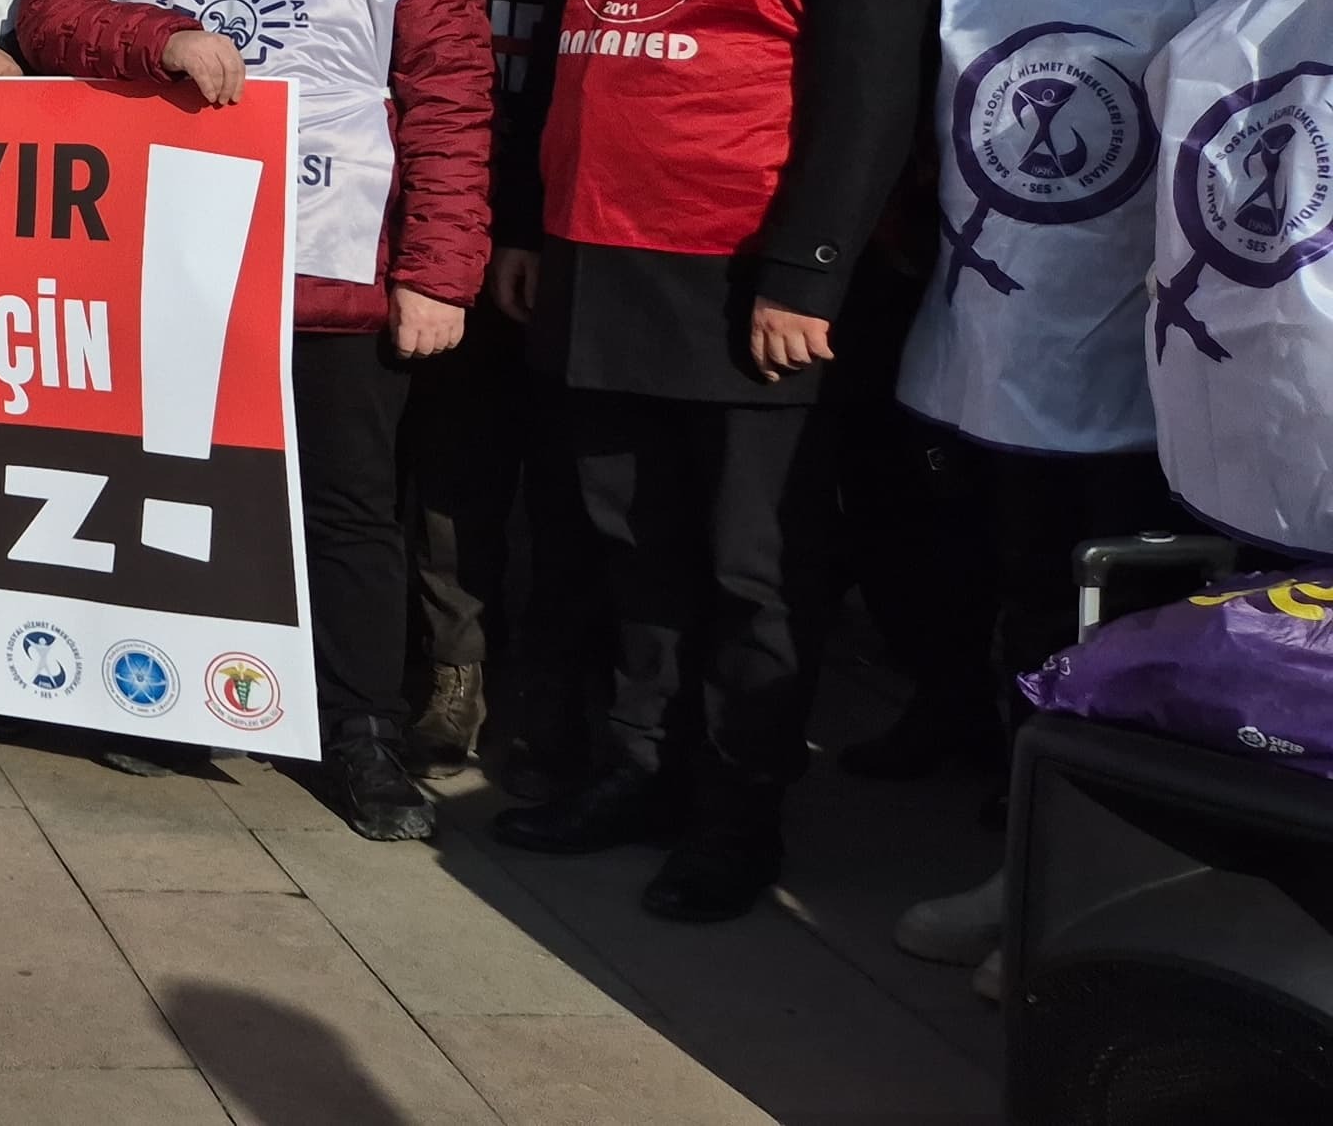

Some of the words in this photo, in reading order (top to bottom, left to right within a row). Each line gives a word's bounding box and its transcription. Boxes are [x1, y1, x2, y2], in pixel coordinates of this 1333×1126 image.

[603, 0, 638, 17] 2011
[558, 29, 699, 60] ANKAHED
[1018, 62, 1064, 80] HİZMET
[984, 76, 1015, 117] SOSYAL
[1066, 64, 1126, 125] EMEKÇİLERİ
[1215, 121, 1265, 161] SOSYAL
[297, 154, 332, 187] SI
[982, 139, 1011, 179] SAĞLIK
[1078, 129, 1125, 188] SENDİKASI
[1029, 183, 1052, 194] SES
[1247, 239, 1268, 253] SES
